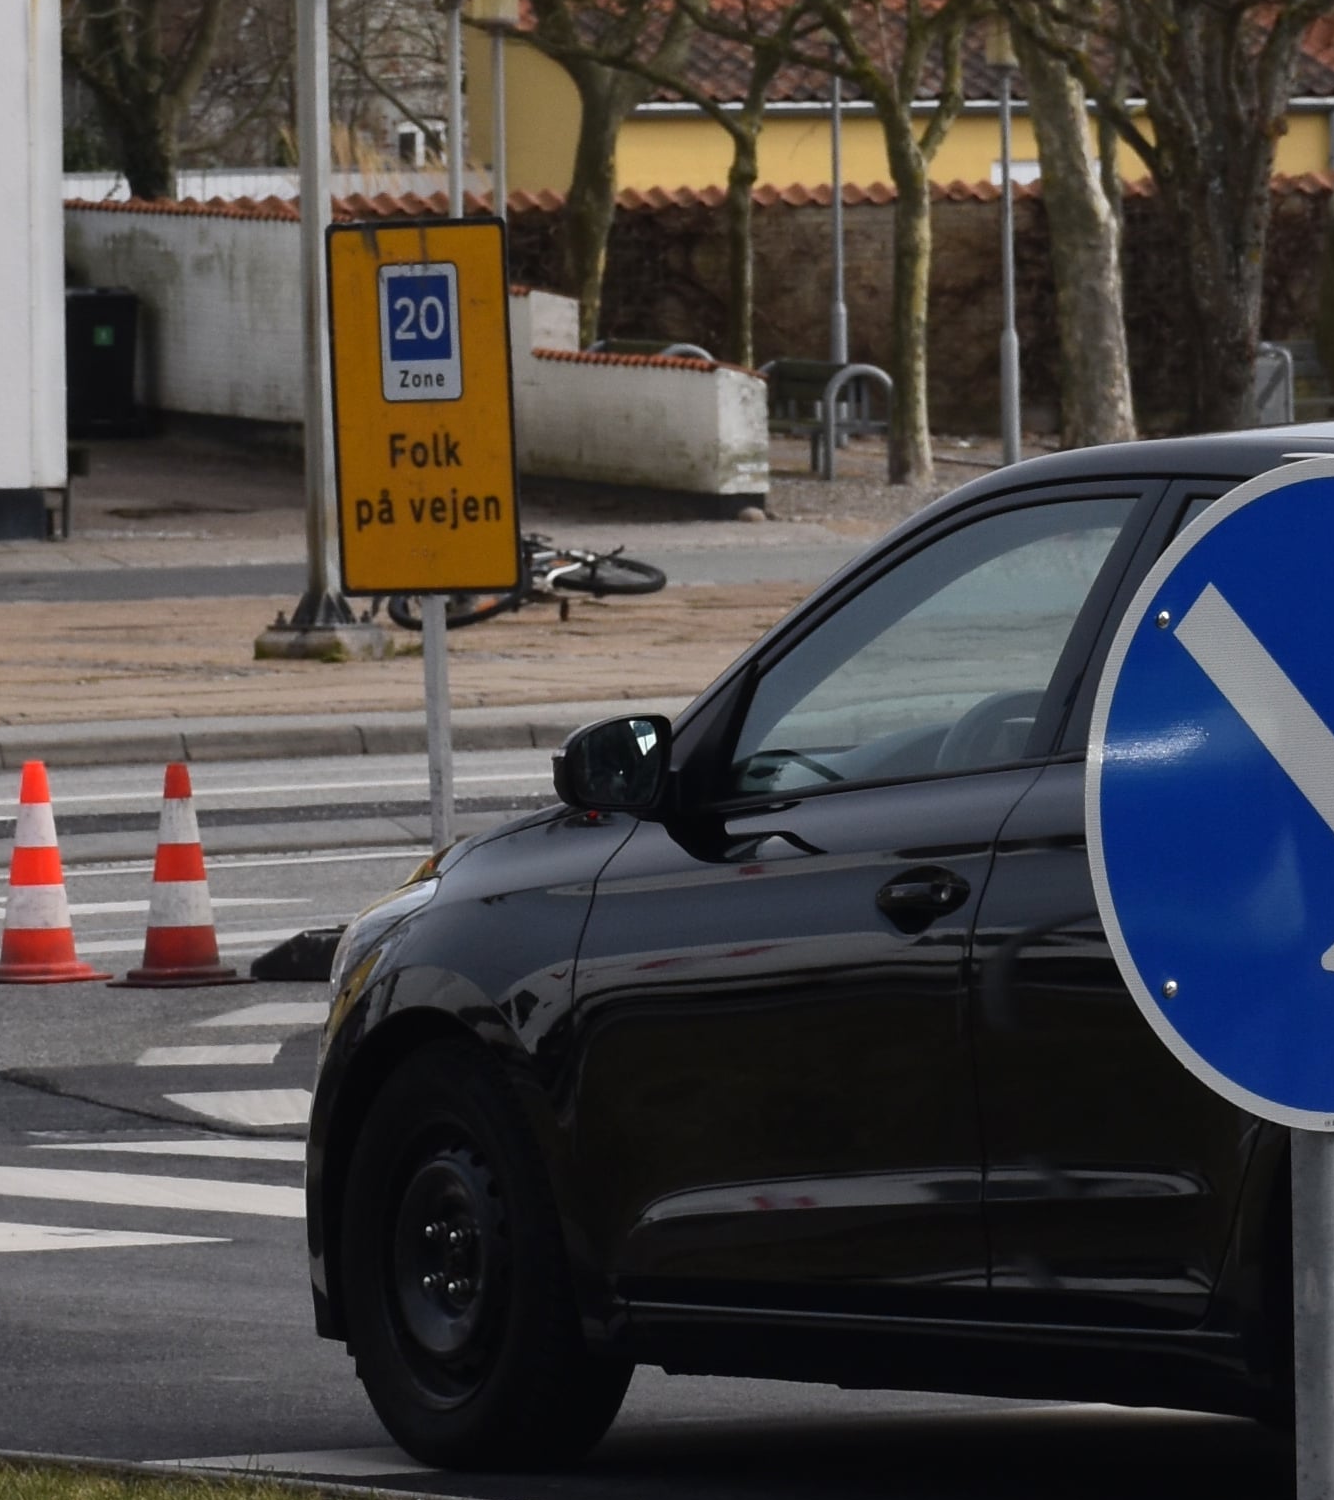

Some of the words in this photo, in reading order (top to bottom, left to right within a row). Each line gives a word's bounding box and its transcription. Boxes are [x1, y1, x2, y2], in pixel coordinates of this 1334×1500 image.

[394, 296, 445, 340] 20
[399, 369, 445, 388] Zone
[389, 432, 462, 468] Folk
[356, 488, 395, 532] på
[409, 487, 501, 530] vejen
